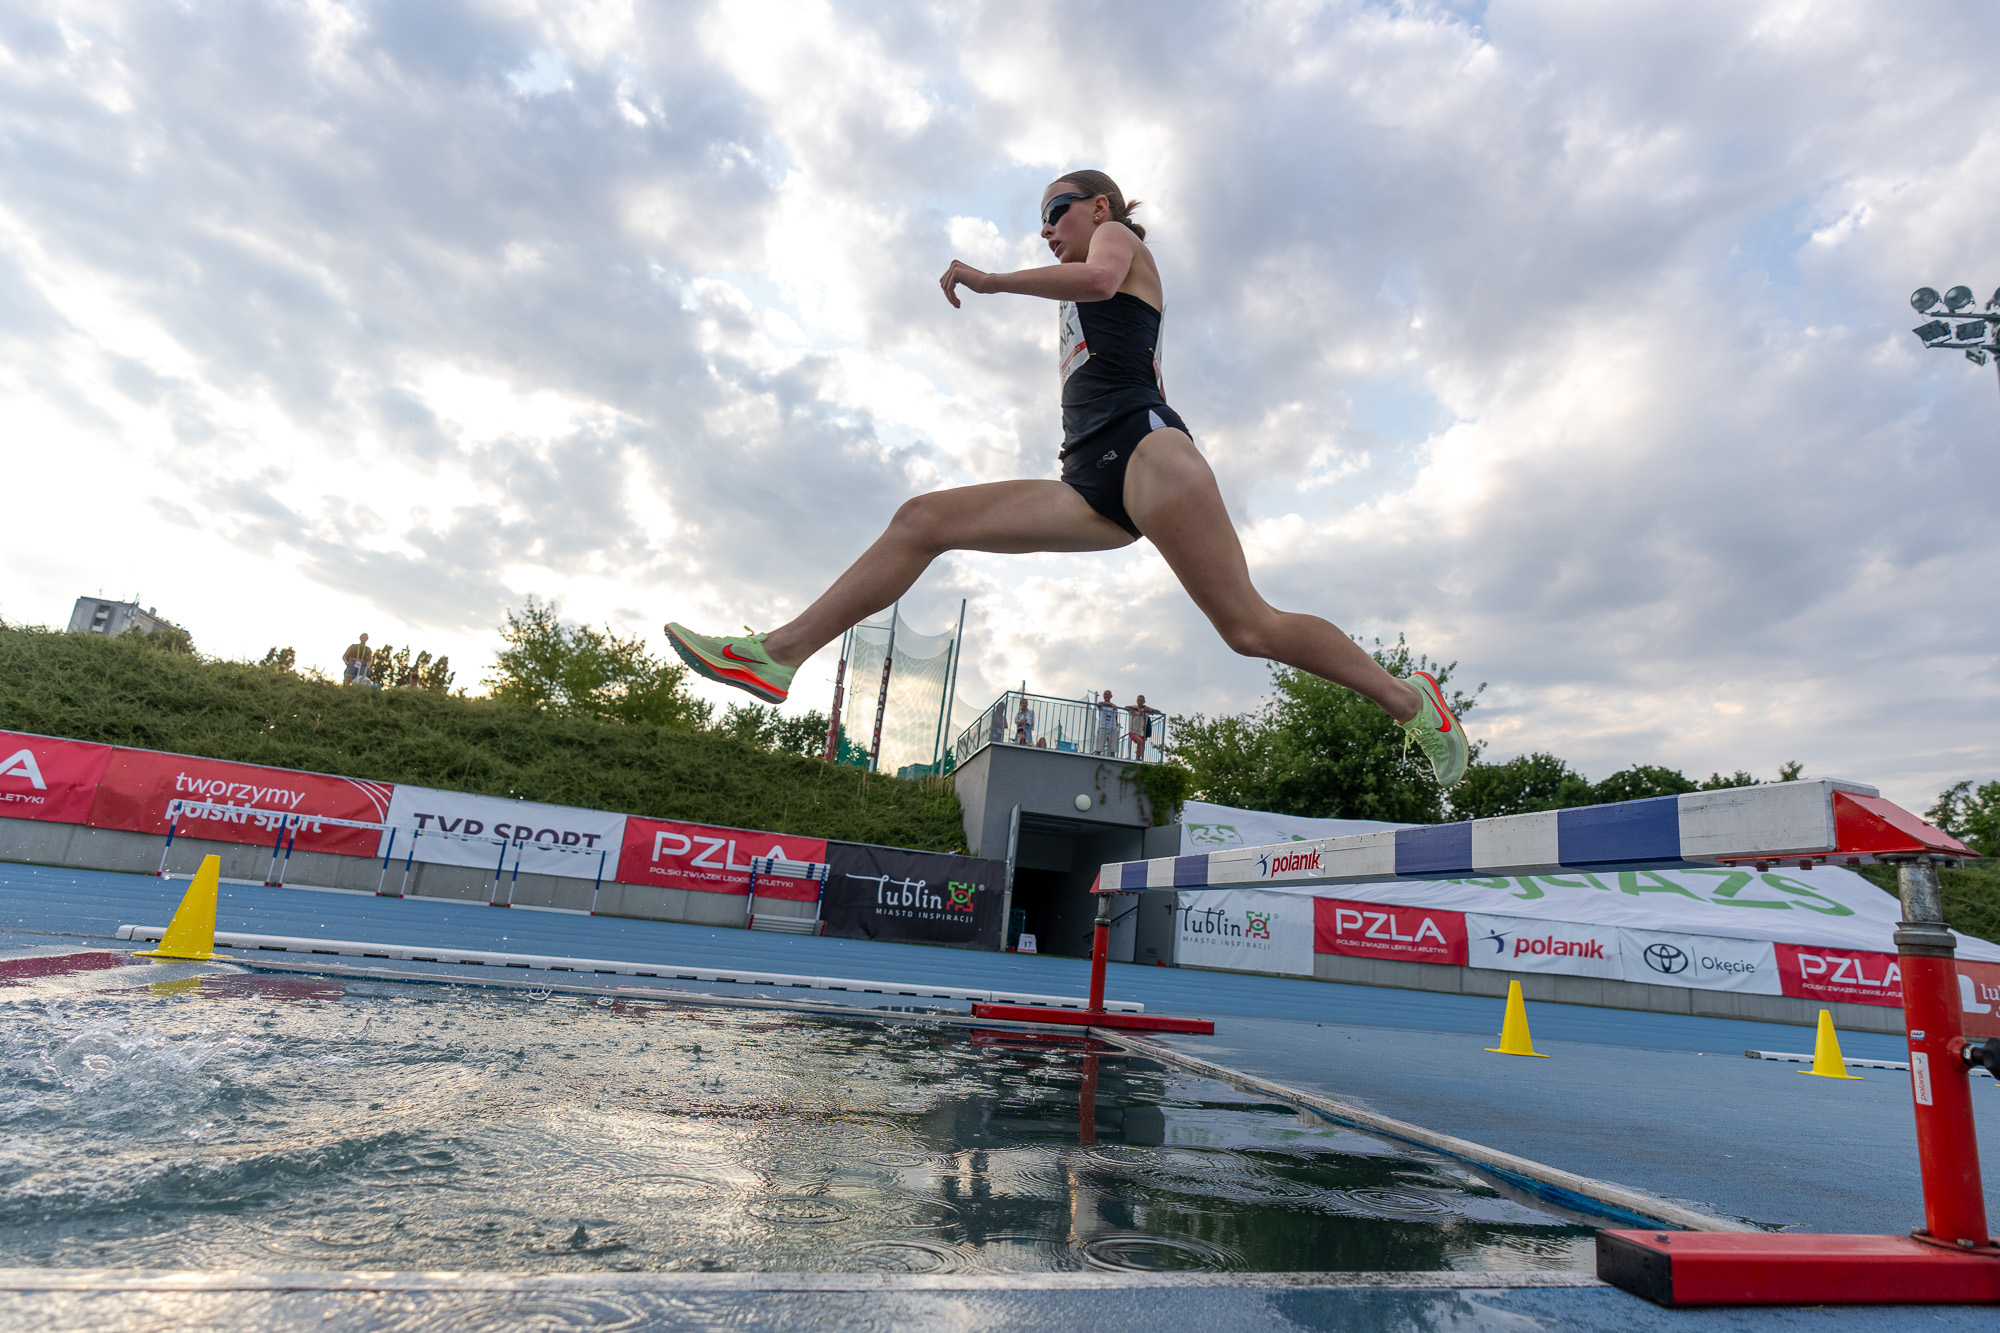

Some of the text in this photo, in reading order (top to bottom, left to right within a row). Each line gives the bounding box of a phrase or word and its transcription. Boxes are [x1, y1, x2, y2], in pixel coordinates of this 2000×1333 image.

[0, 793, 45, 804] LETYKI
[175, 772, 306, 810] tworzymy
[413, 812, 484, 841] TVP
[1270, 848, 1322, 878] polanik
[649, 867, 681, 876] POLSKI
[722, 875, 751, 884] LEKKIE
[756, 879, 794, 888] ATLETYKI
[876, 908, 973, 923] MIASTO INSPIRACJI
[1335, 908, 1447, 944] PZLA
[1183, 936, 1270, 950] MIASTO INSPIRACJI
[1513, 935, 1604, 959] polanik
[1701, 956, 1755, 975] Okęcie
